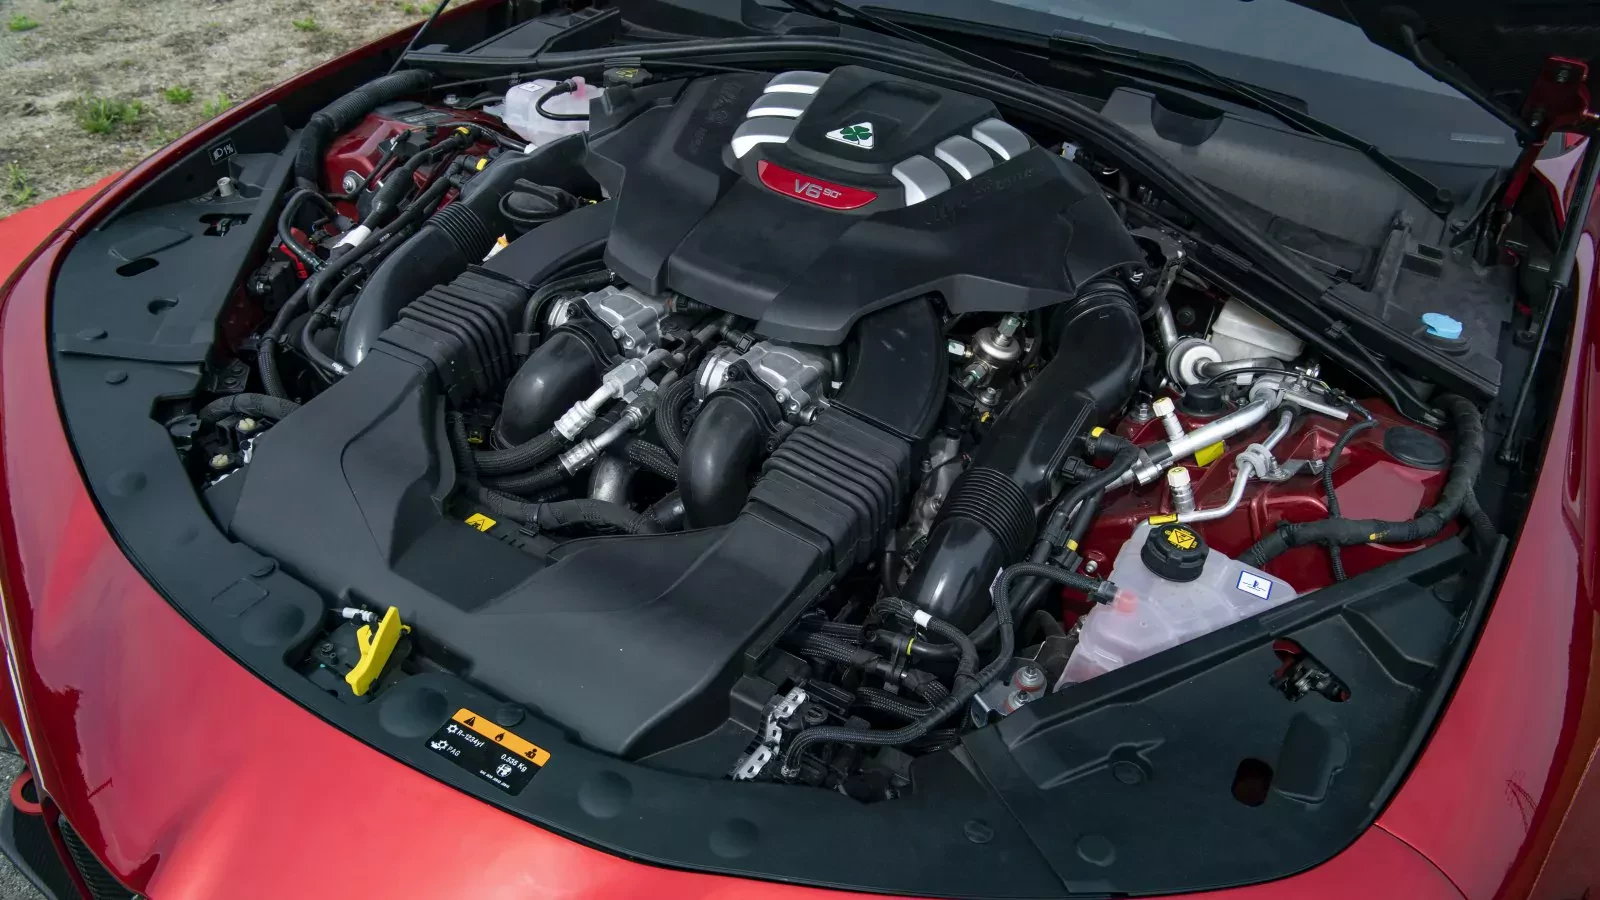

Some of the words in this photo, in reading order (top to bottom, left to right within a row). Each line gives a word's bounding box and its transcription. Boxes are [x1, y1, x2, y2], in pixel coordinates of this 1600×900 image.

[795, 179, 822, 199] V6
[447, 745, 461, 757] PAG
[500, 753, 518, 767] 0.535
[517, 762, 528, 773] Kg
